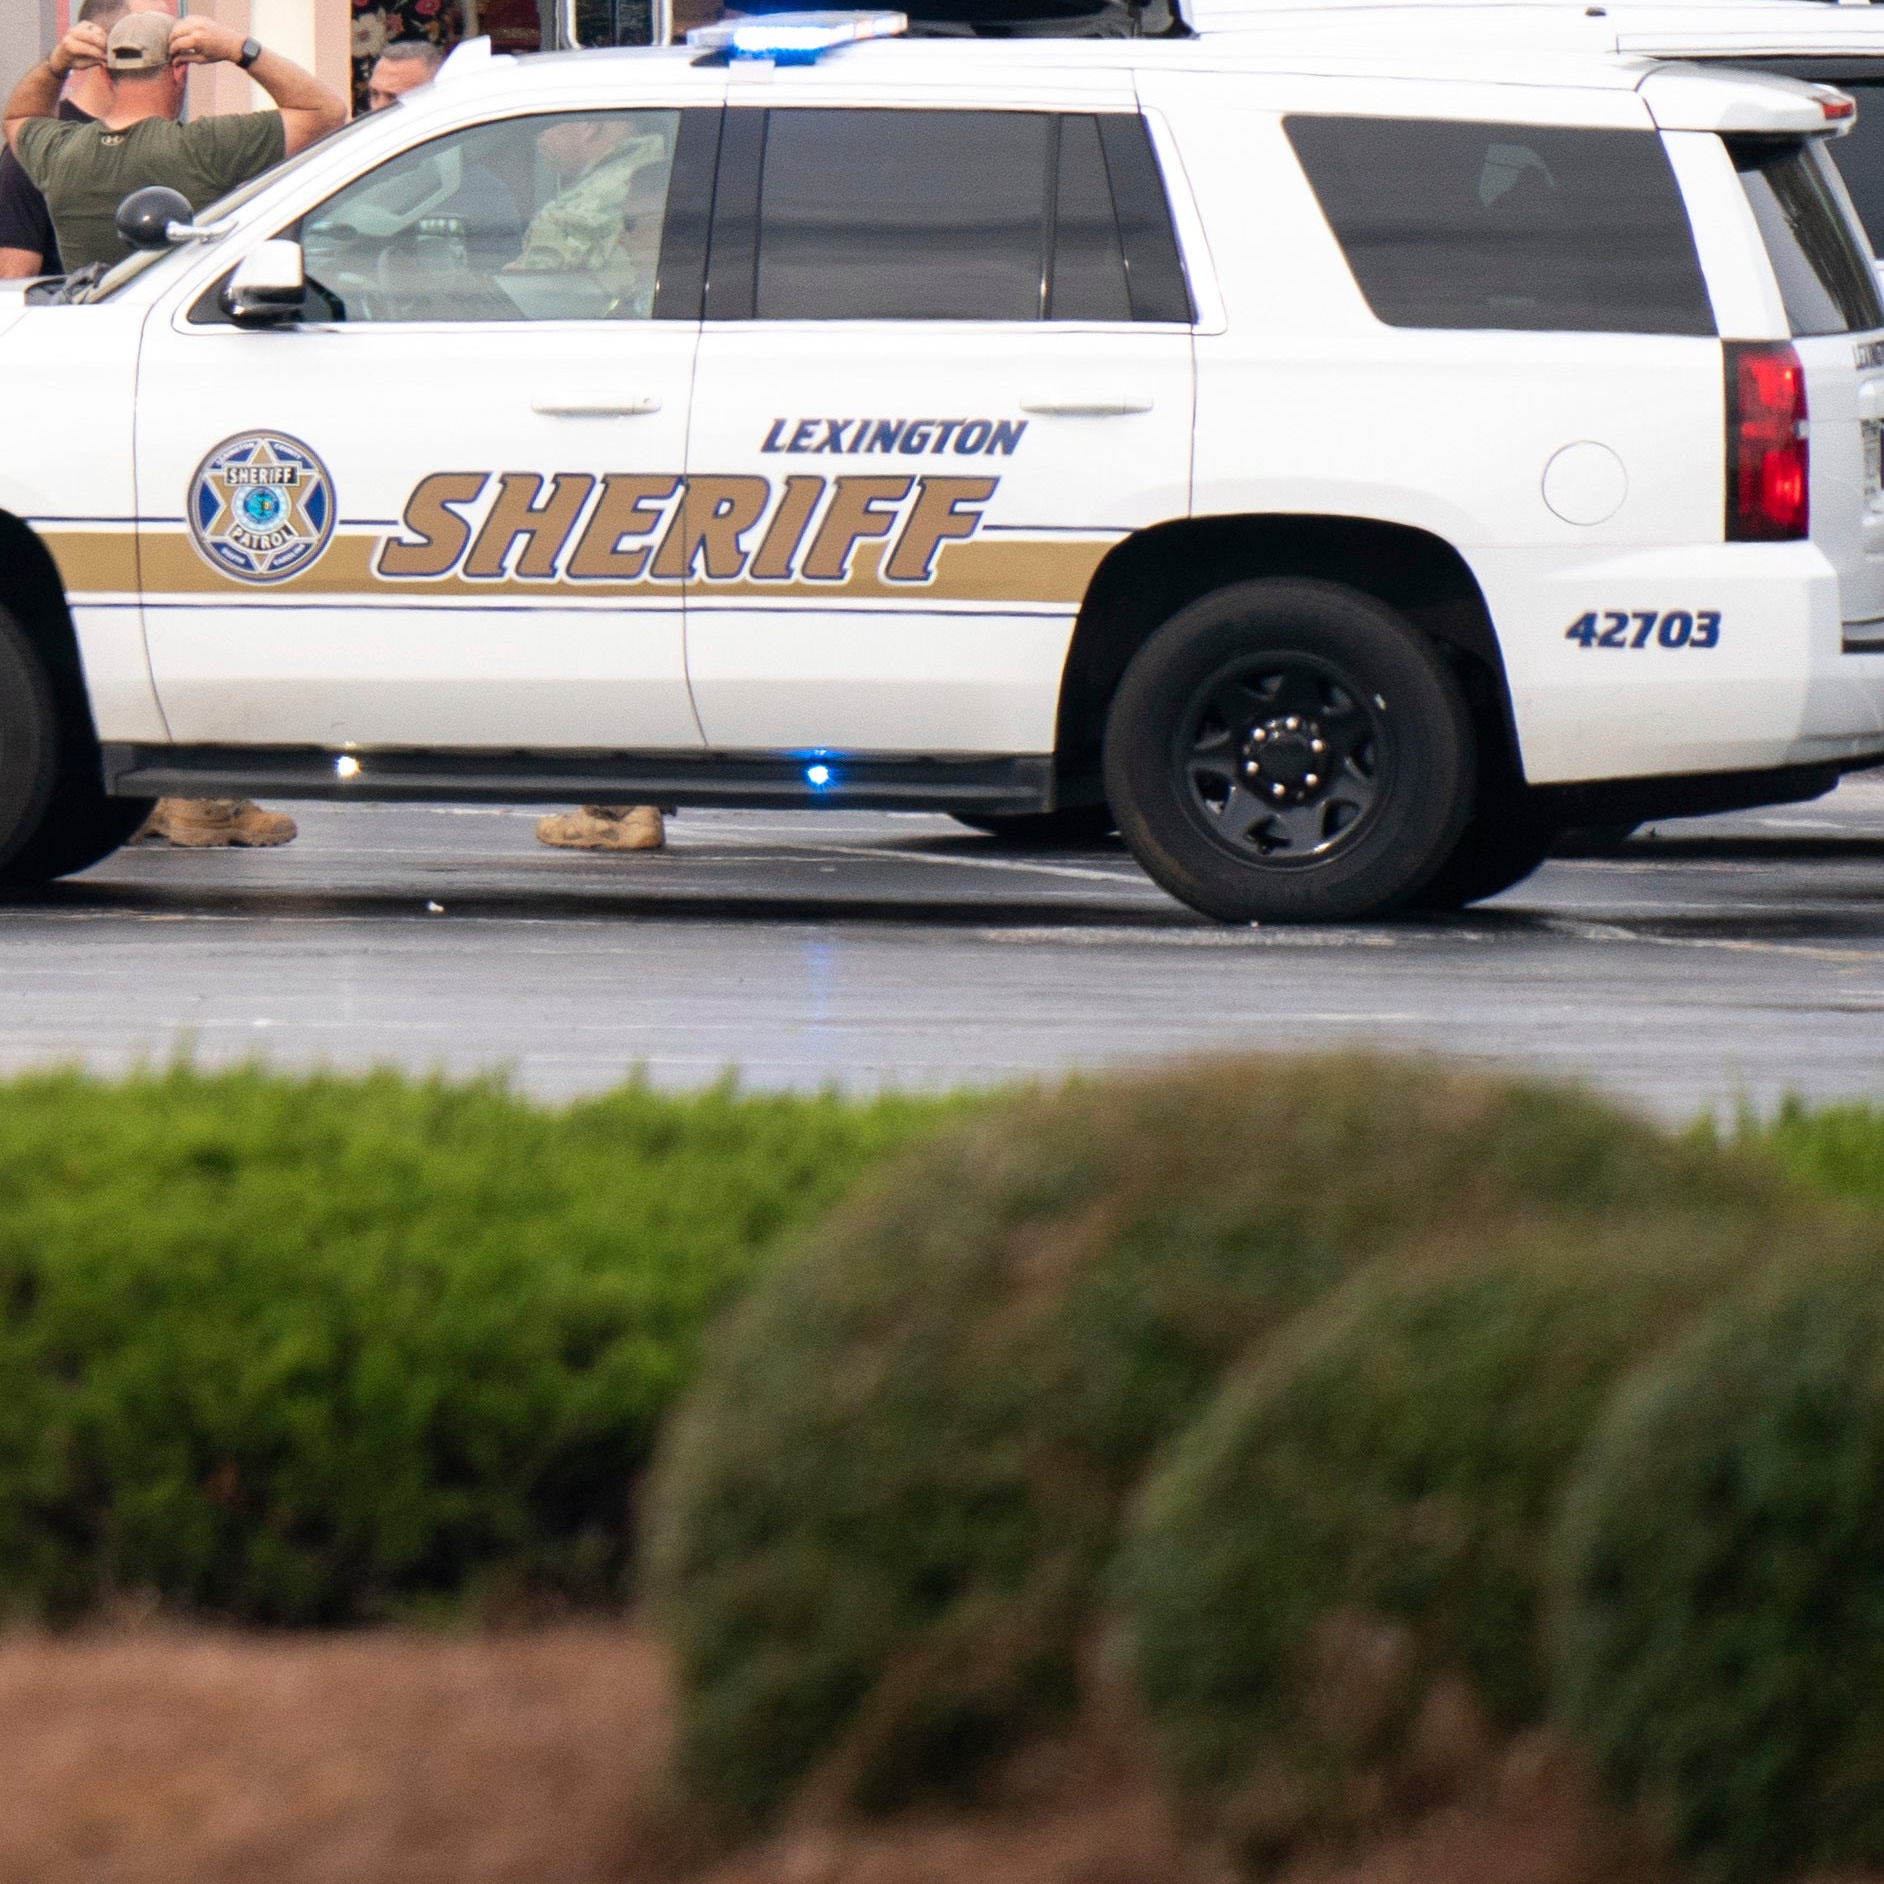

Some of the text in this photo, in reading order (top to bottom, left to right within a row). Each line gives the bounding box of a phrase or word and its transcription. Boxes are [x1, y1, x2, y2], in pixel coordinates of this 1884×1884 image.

[760, 418, 1029, 456] LEXINGTON
[229, 467, 293, 484] SHERIFF
[232, 524, 294, 550] PATROL
[376, 471, 1001, 582] SHERIFF
[1564, 609, 1722, 649] 42703
